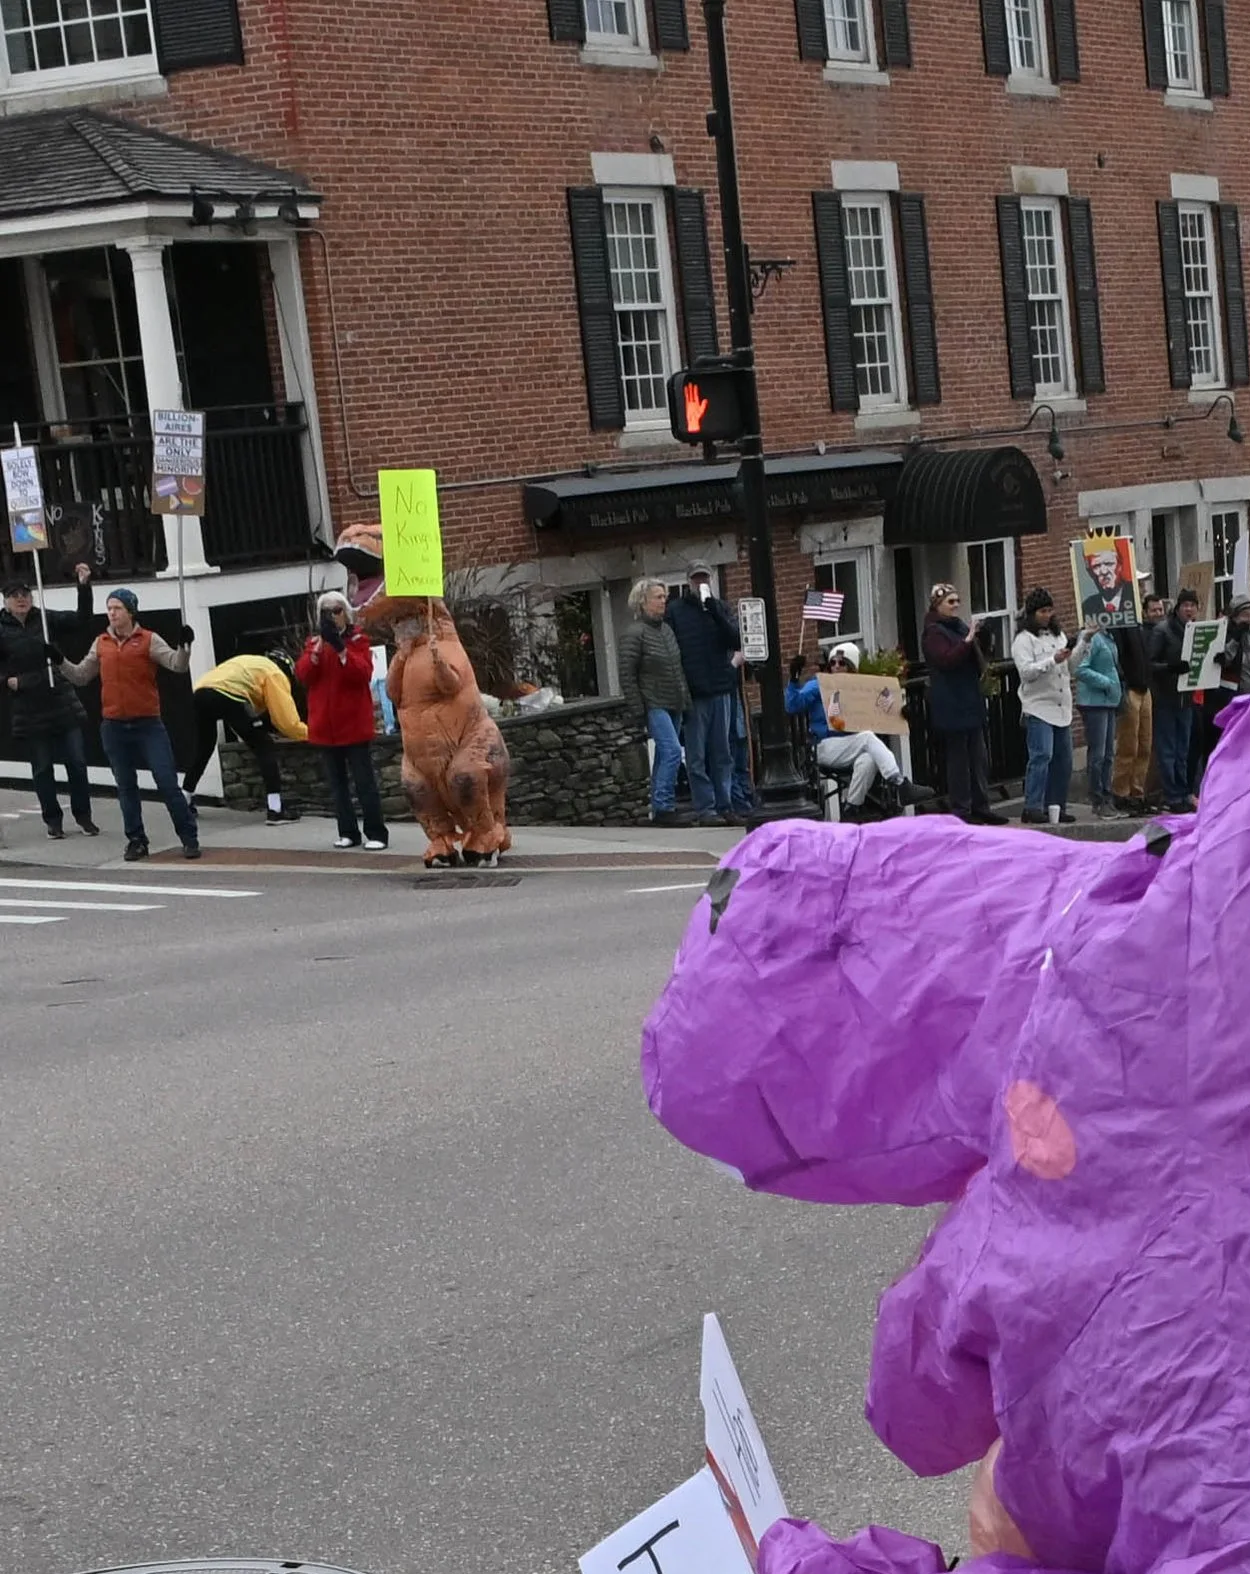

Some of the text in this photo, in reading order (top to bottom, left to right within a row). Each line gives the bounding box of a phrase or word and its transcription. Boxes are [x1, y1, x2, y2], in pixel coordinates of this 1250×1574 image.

[164, 423, 193, 433] AIRES
[159, 437, 197, 447] ARE THE
[166, 447, 191, 456] ONLY
[157, 464, 200, 474] MINORITY
[11, 479, 34, 489] DOWN
[395, 481, 428, 515] No
[632, 508, 649, 525] Pub
[1085, 611, 1136, 627] NOPE
